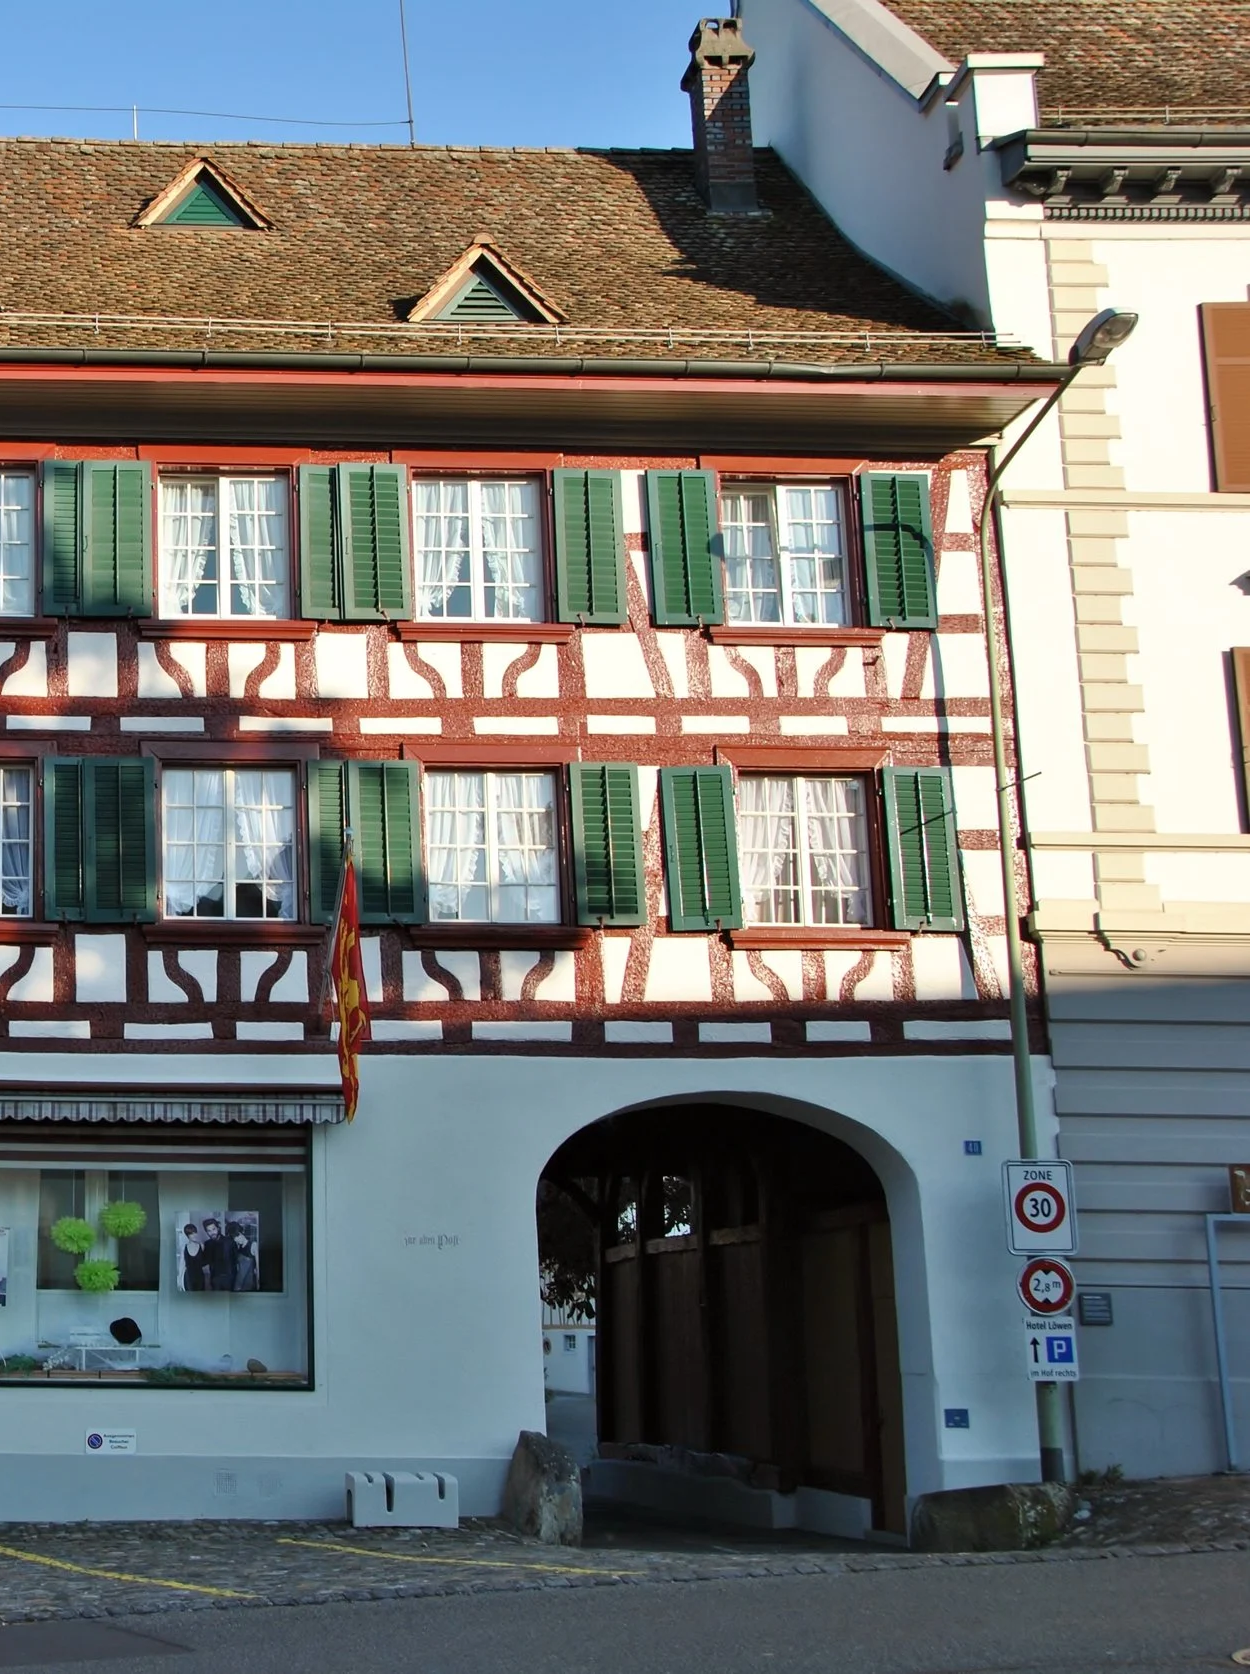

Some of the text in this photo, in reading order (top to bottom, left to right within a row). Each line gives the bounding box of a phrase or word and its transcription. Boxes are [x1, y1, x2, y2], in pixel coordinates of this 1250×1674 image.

[1023, 1170, 1053, 1181] ZONE
[1029, 1197, 1051, 1218] 30
[1026, 1320, 1072, 1331] Hotel Löwen
[1053, 1340, 1066, 1359] P
[1030, 1369, 1077, 1379] im Hof rechts
